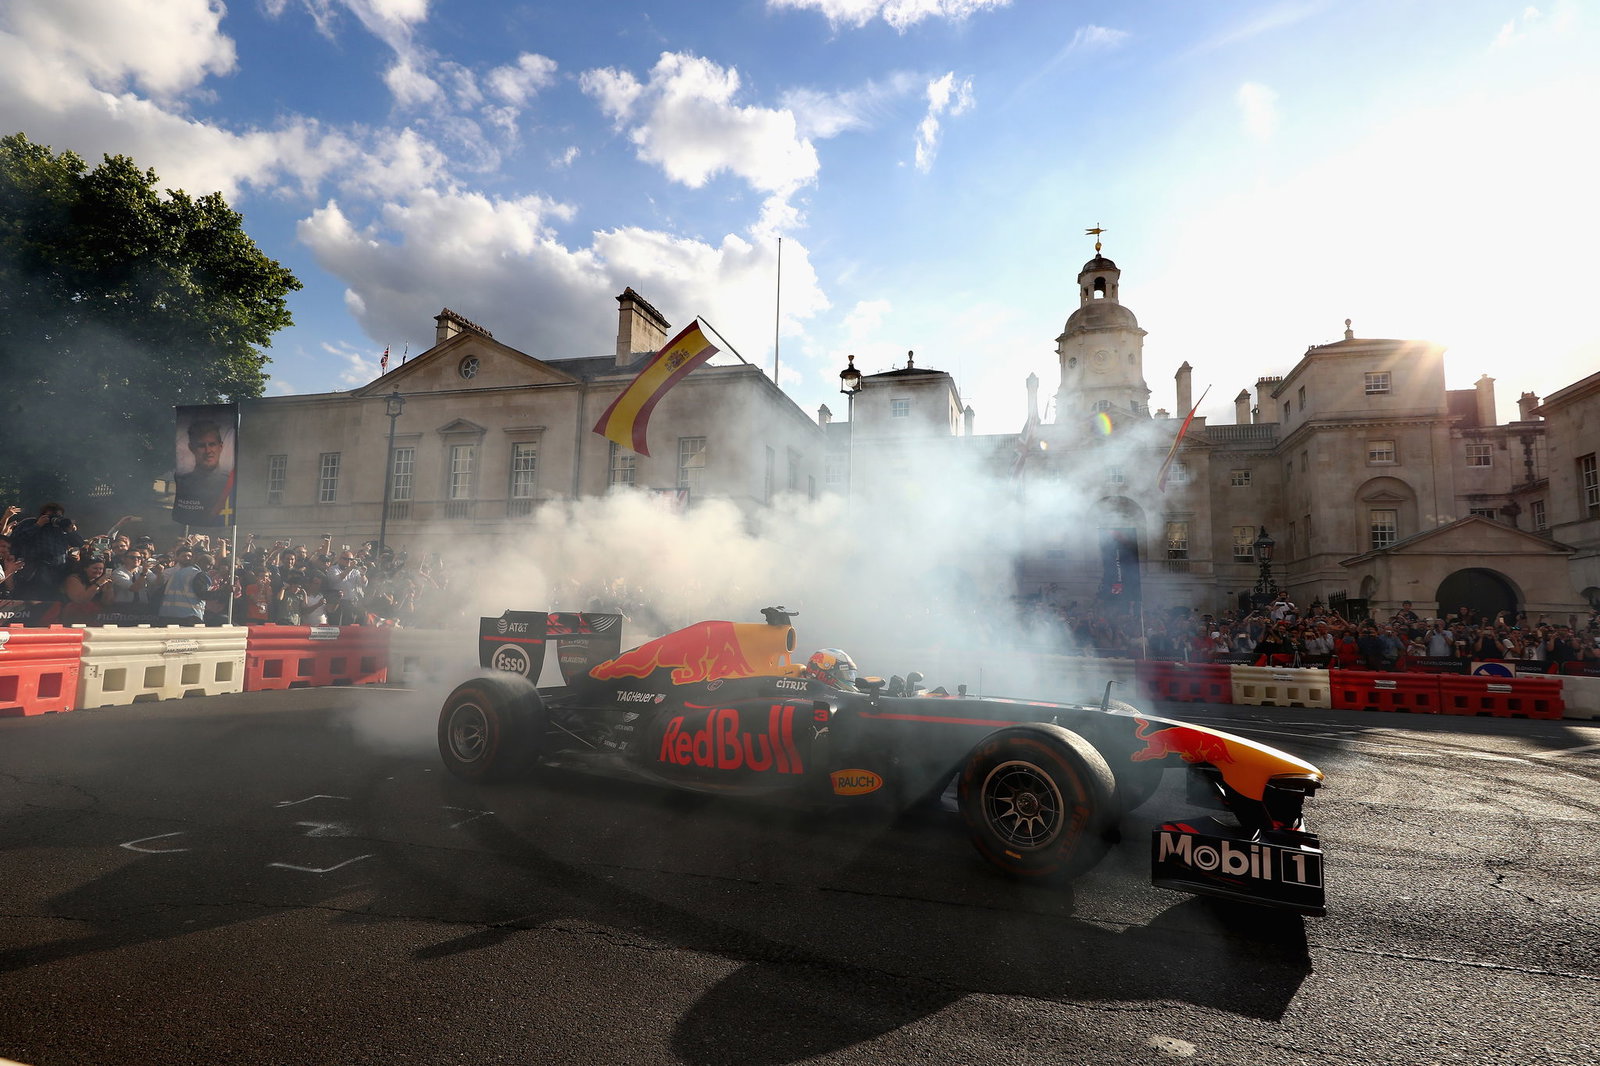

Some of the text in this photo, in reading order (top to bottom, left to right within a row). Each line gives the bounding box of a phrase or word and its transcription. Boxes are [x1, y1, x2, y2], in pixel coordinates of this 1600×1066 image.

[508, 622, 529, 633] AT&T
[814, 709, 829, 721] 3
[838, 776, 874, 788] RAUCH
[1158, 832, 1306, 883] Mobil 1
